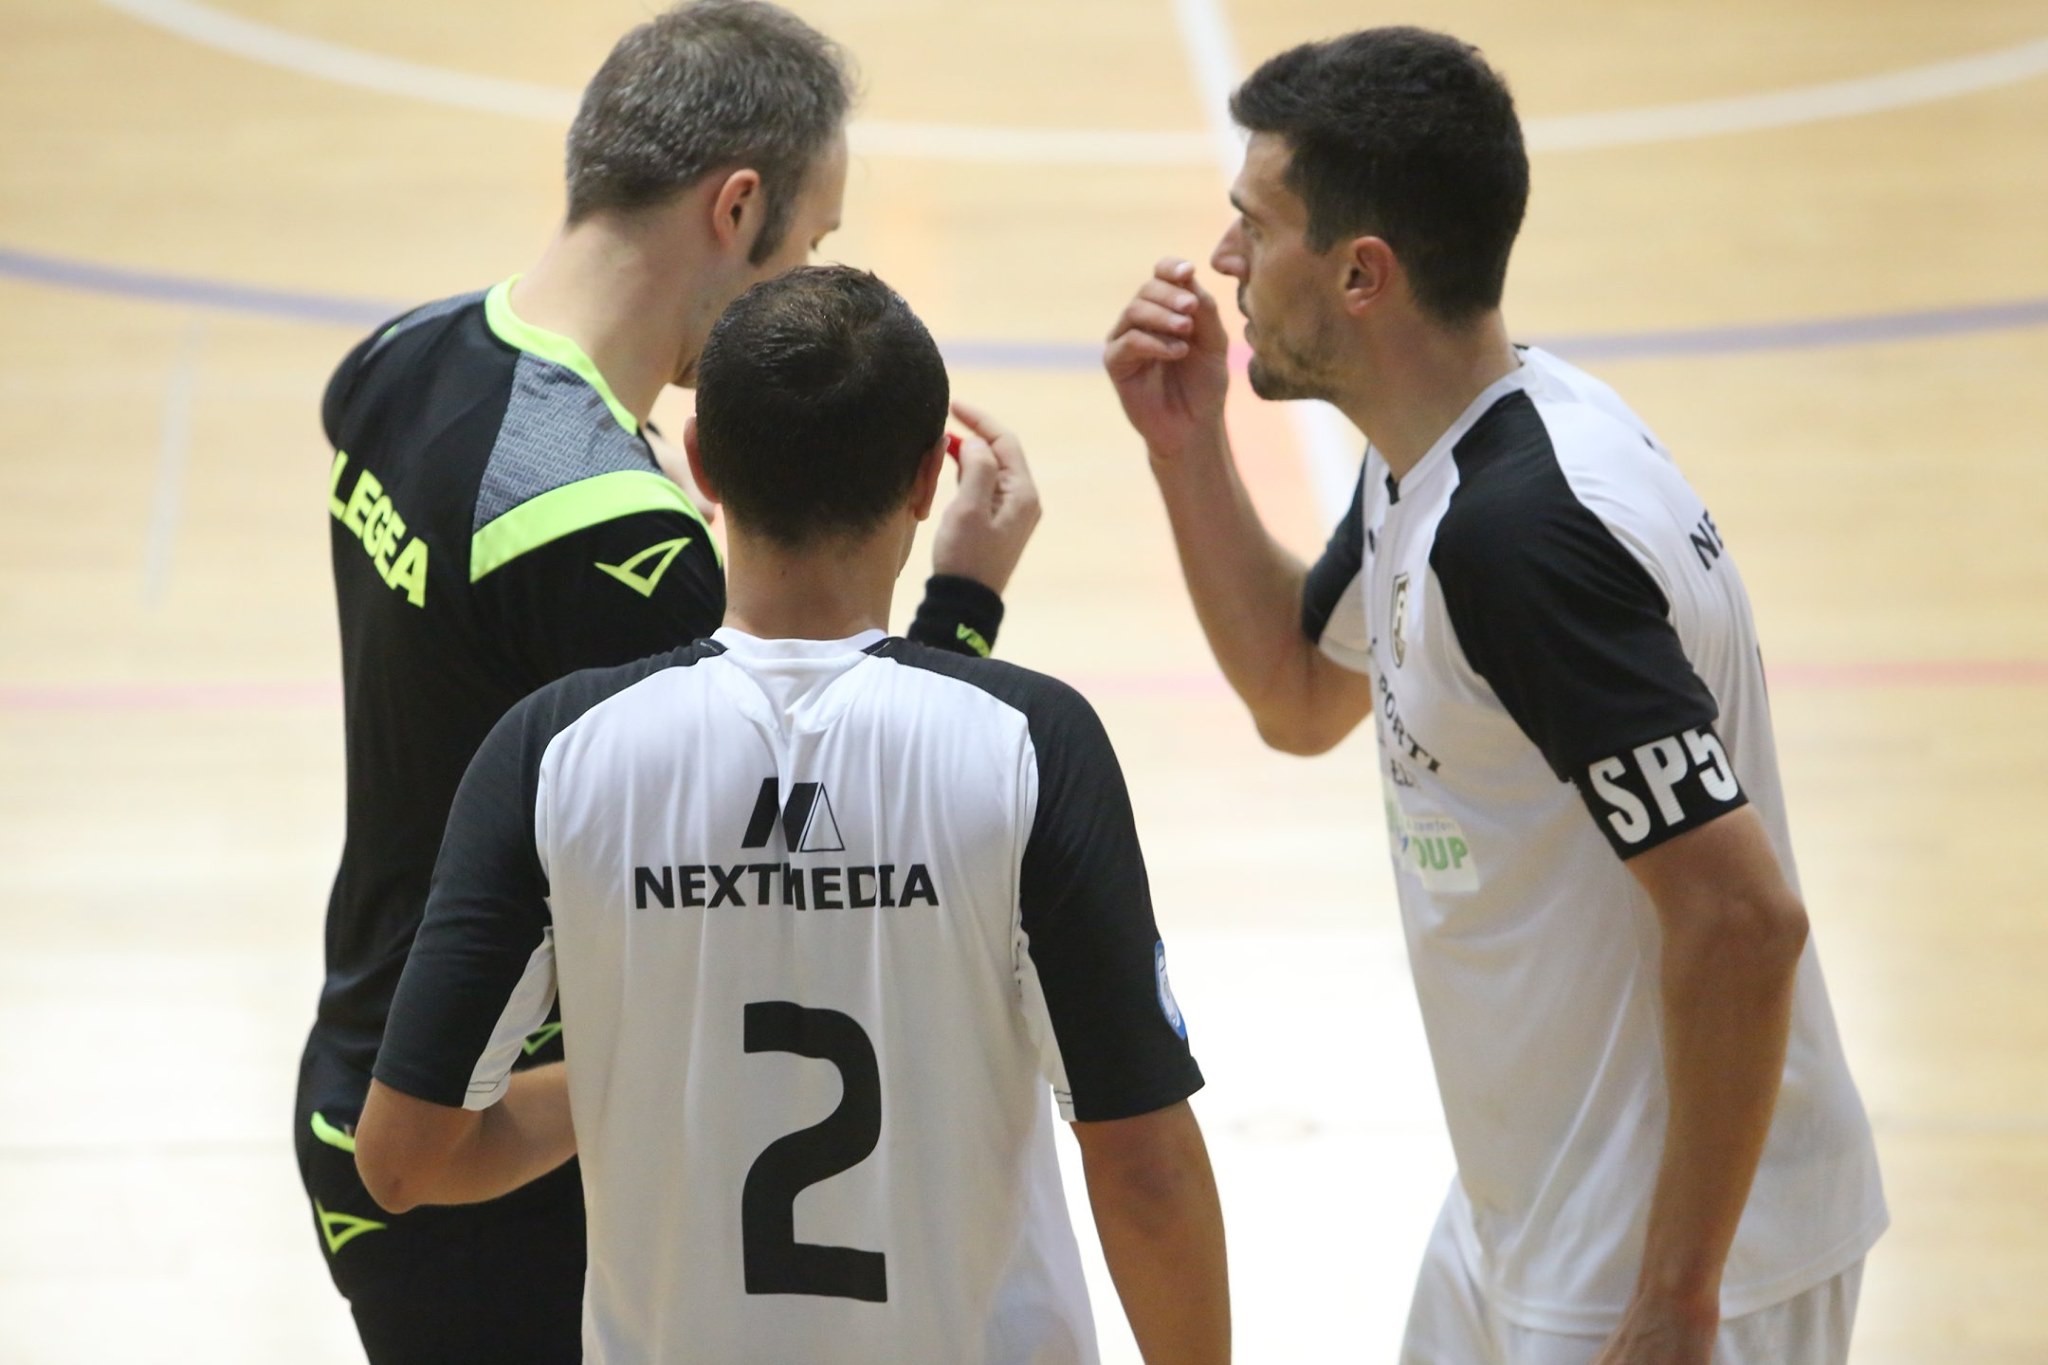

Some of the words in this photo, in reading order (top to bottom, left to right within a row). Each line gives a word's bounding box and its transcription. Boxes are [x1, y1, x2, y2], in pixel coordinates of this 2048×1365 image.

[328, 450, 429, 609] LEGEA
[1588, 728, 1739, 844] SP5
[634, 862, 940, 911] NEXTMEDIA
[741, 1001, 888, 1303] 2
